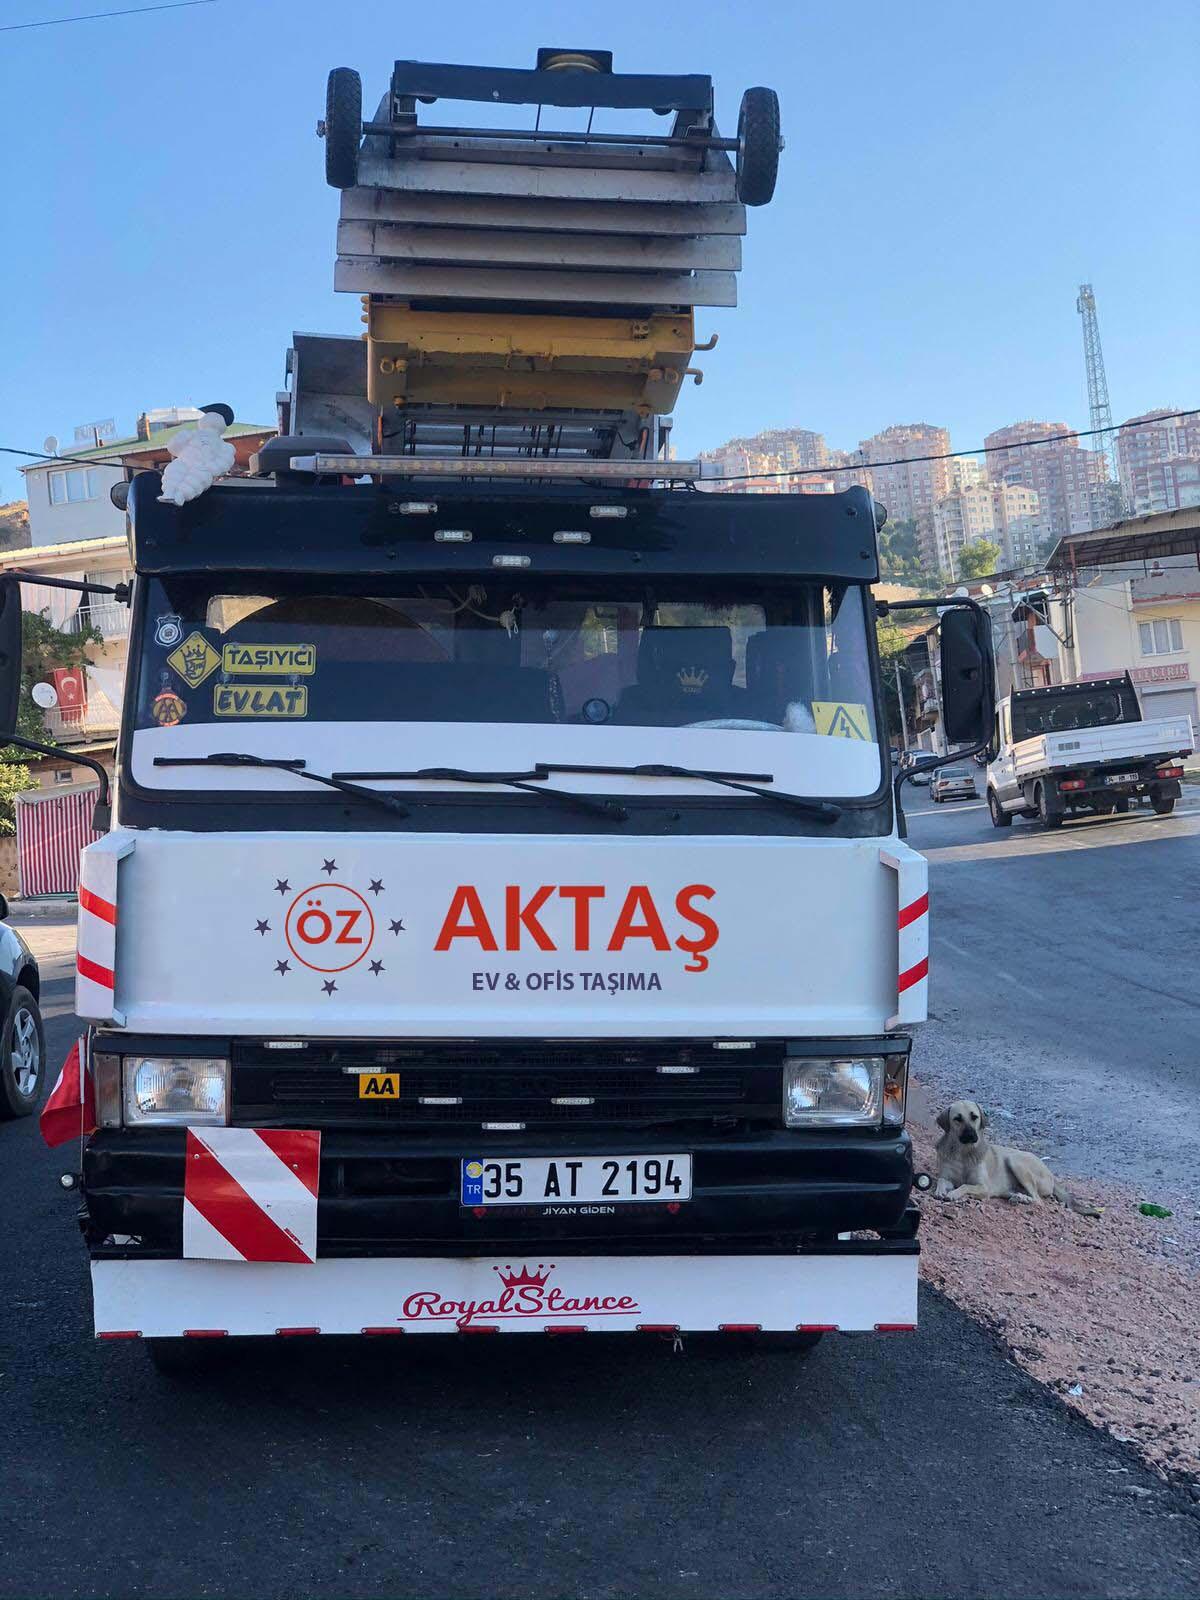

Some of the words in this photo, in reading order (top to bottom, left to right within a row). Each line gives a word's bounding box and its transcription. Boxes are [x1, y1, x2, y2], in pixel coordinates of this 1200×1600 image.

[228, 651, 312, 670] TAŞIYICI
[217, 690, 303, 713] EVLAT
[297, 900, 363, 944] ÖZ
[434, 884, 719, 972] AKTAŞ
[472, 973, 499, 990] EV
[505, 973, 521, 991] &
[526, 969, 575, 991] OFİS
[579, 973, 662, 995] TAŞIMA
[364, 1077, 395, 1095] AA
[467, 1185, 481, 1195] TR
[484, 1163, 523, 1198] 35
[544, 1162, 582, 1197] AT
[602, 1160, 682, 1195] 2194
[402, 1288, 514, 1326] Royal
[514, 1286, 638, 1314] Stance
